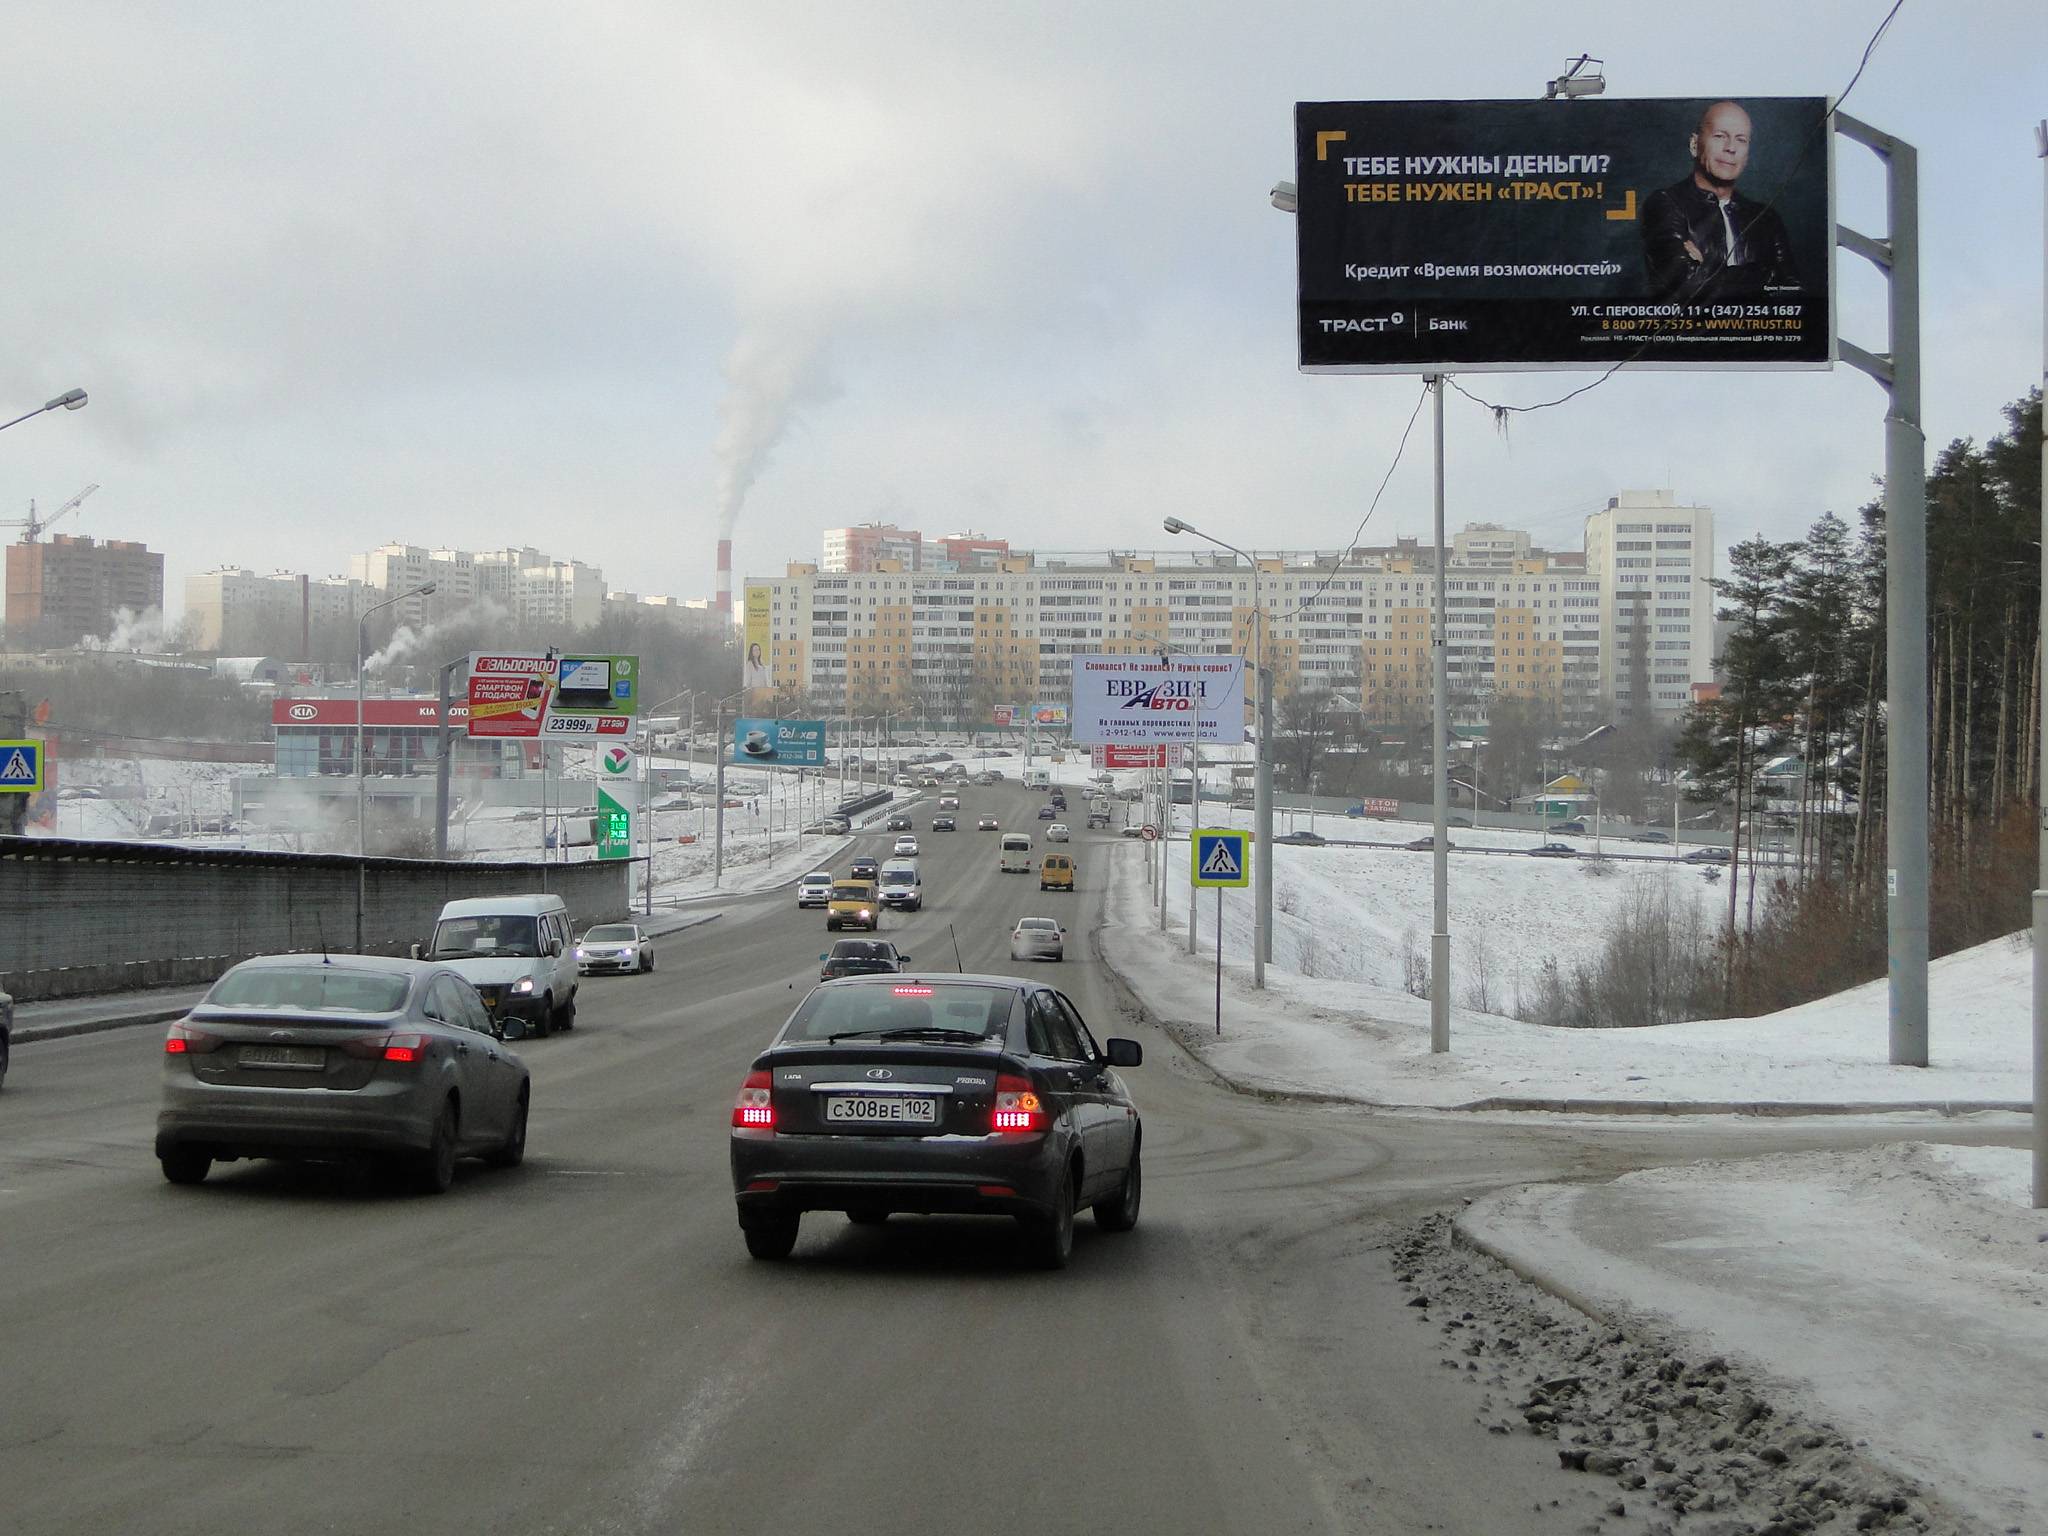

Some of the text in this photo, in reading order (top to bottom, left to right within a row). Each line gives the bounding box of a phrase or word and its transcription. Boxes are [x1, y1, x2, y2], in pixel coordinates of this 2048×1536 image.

[1343, 154, 1611, 177] ТЕБЕ НУЖНЫ ДЕНЬГИ?
[1344, 181, 1603, 202] ТЕБЕ НУЖЕН «ТРАСТ»!
[1345, 260, 1622, 281] Кредит «Время возможностей»
[1571, 303, 1802, 318] УЛ. С. ПЕРОВСКОЙ, 11 (347) 254 1687
[1319, 318, 1469, 332] ТРАСТ Банк
[1602, 320, 1610, 330] 8
[1612, 320, 1635, 330] 800
[1638, 320, 1660, 330] 775
[1705, 319, 1802, 330] WWW.TRUST.RU
[1085, 662, 1126, 671] Сломался?
[1129, 662, 1139, 671] Не
[482, 692, 522, 700] ПОДАРОК
[294, 708, 312, 716] KIA
[419, 707, 435, 716] KIA
[1099, 719, 1108, 727] На
[955, 1077, 987, 1085] PRIORA
[833, 1100, 930, 1119] С308ВЕ 102
